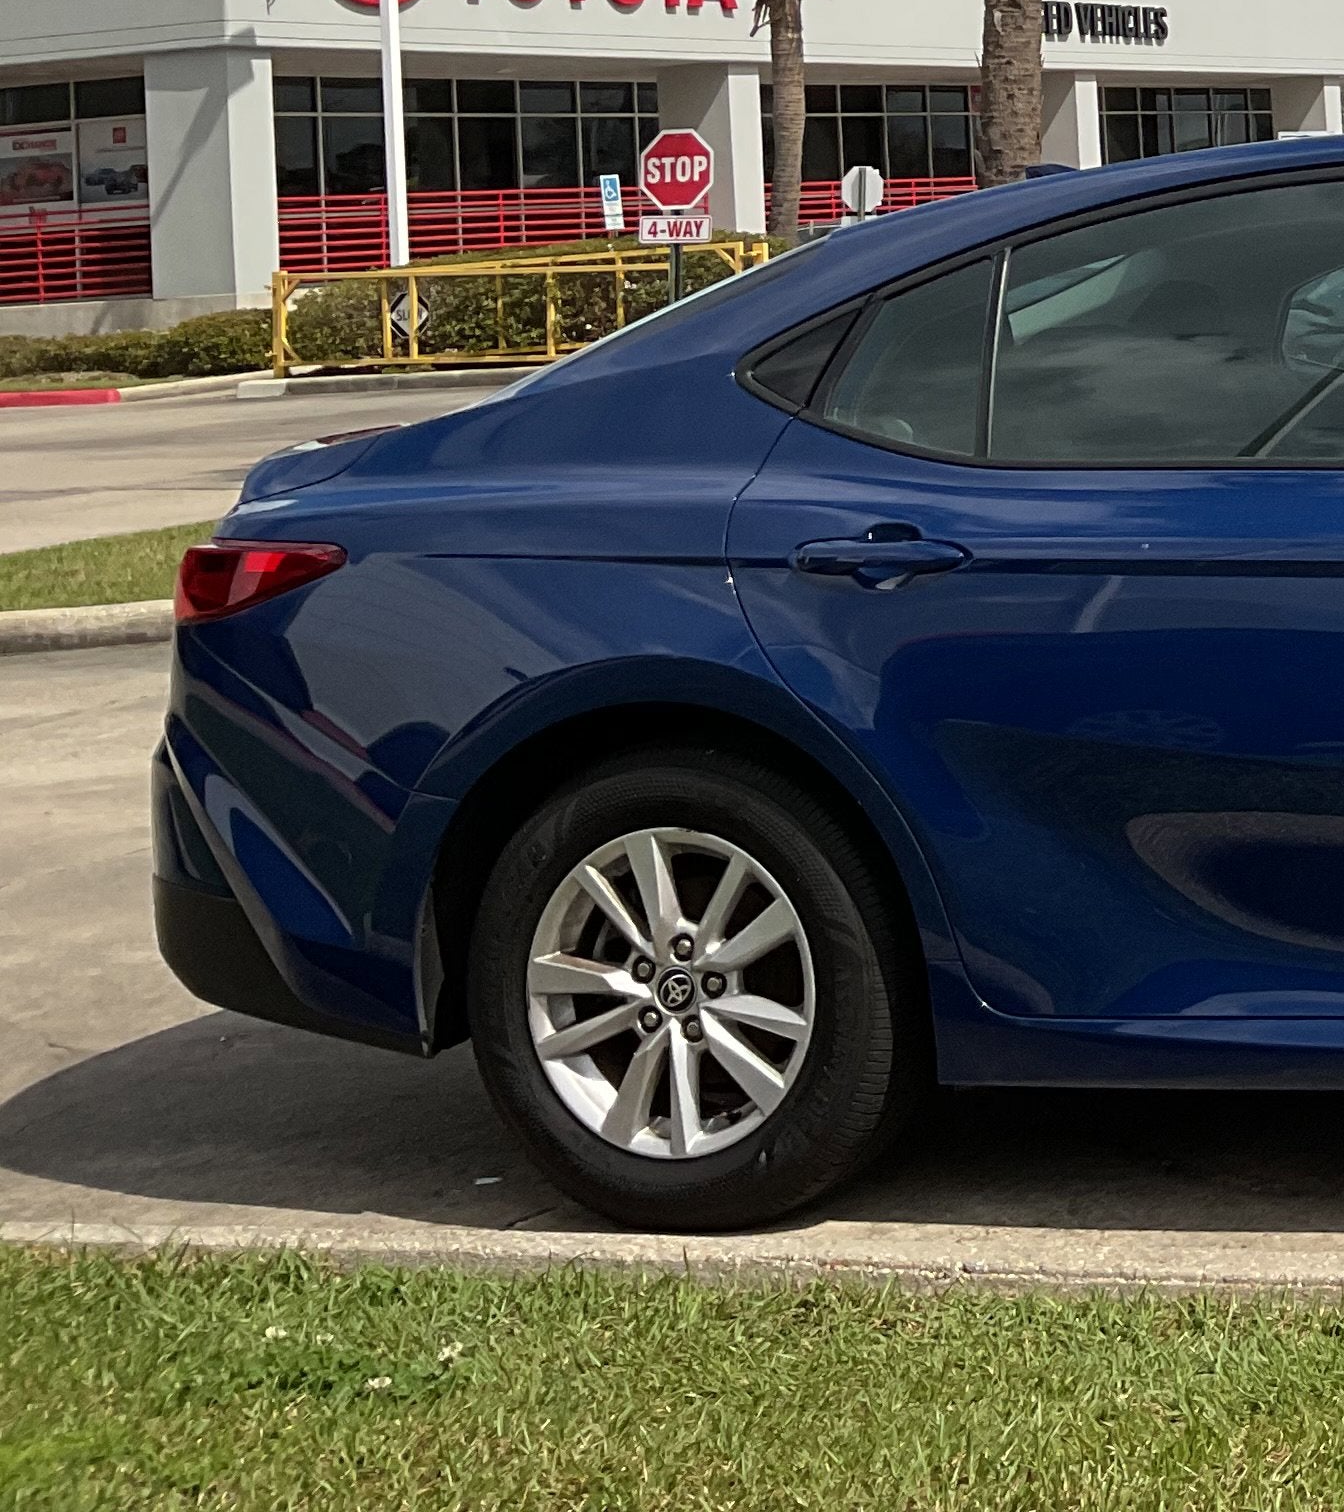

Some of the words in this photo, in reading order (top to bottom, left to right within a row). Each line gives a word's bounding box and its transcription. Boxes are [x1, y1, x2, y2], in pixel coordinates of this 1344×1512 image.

[1074, 2, 1169, 40] VEHICLES
[646, 155, 708, 185] STOP
[647, 220, 704, 239] 4-WAY
